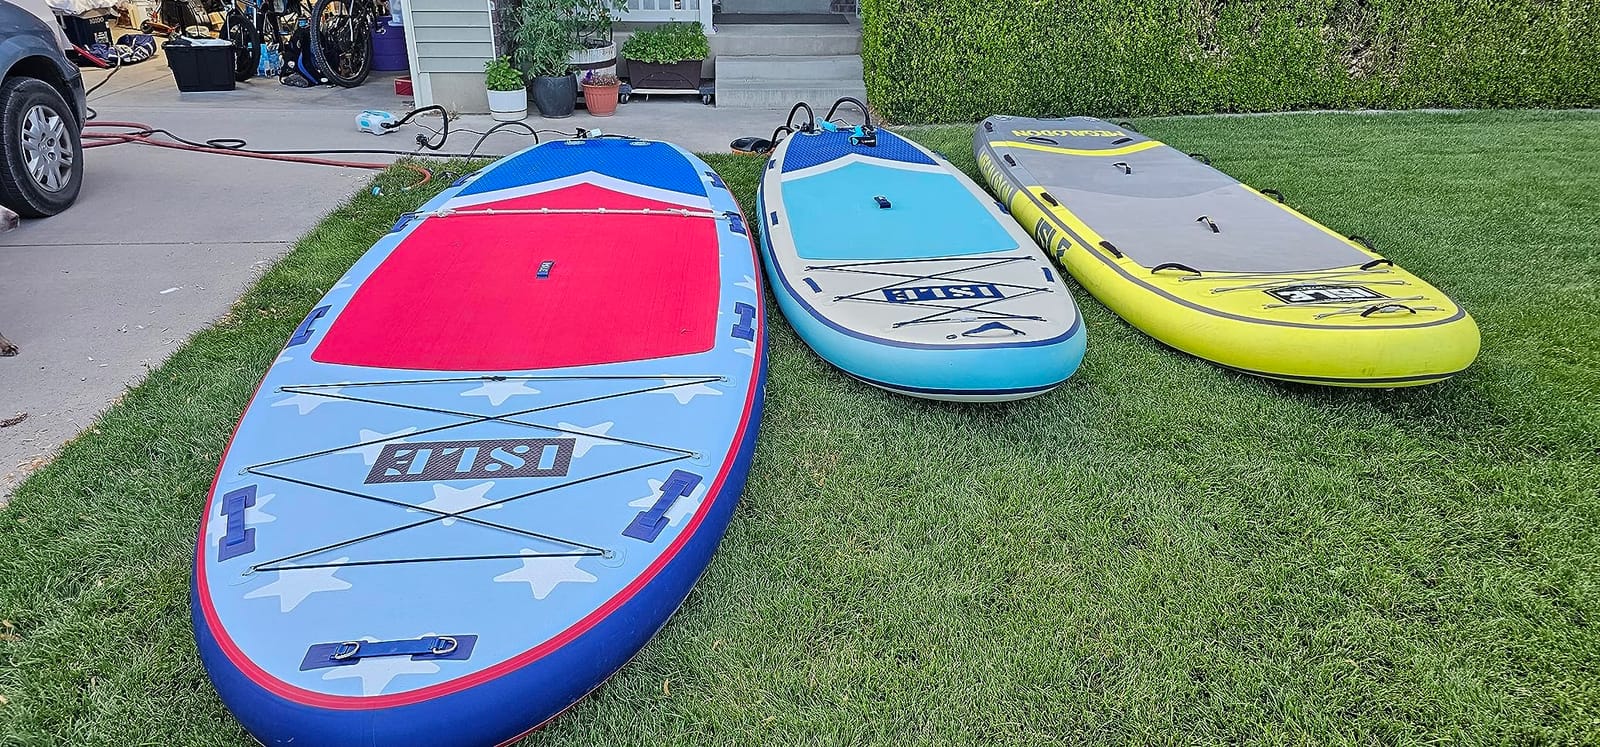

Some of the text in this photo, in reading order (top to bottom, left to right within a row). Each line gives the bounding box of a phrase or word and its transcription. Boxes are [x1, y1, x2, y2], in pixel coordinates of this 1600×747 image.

[1011, 129, 1127, 138] MEGALODON
[891, 285, 995, 301] ISLE
[1276, 286, 1379, 301] ISLE
[384, 443, 560, 477] ISLE
